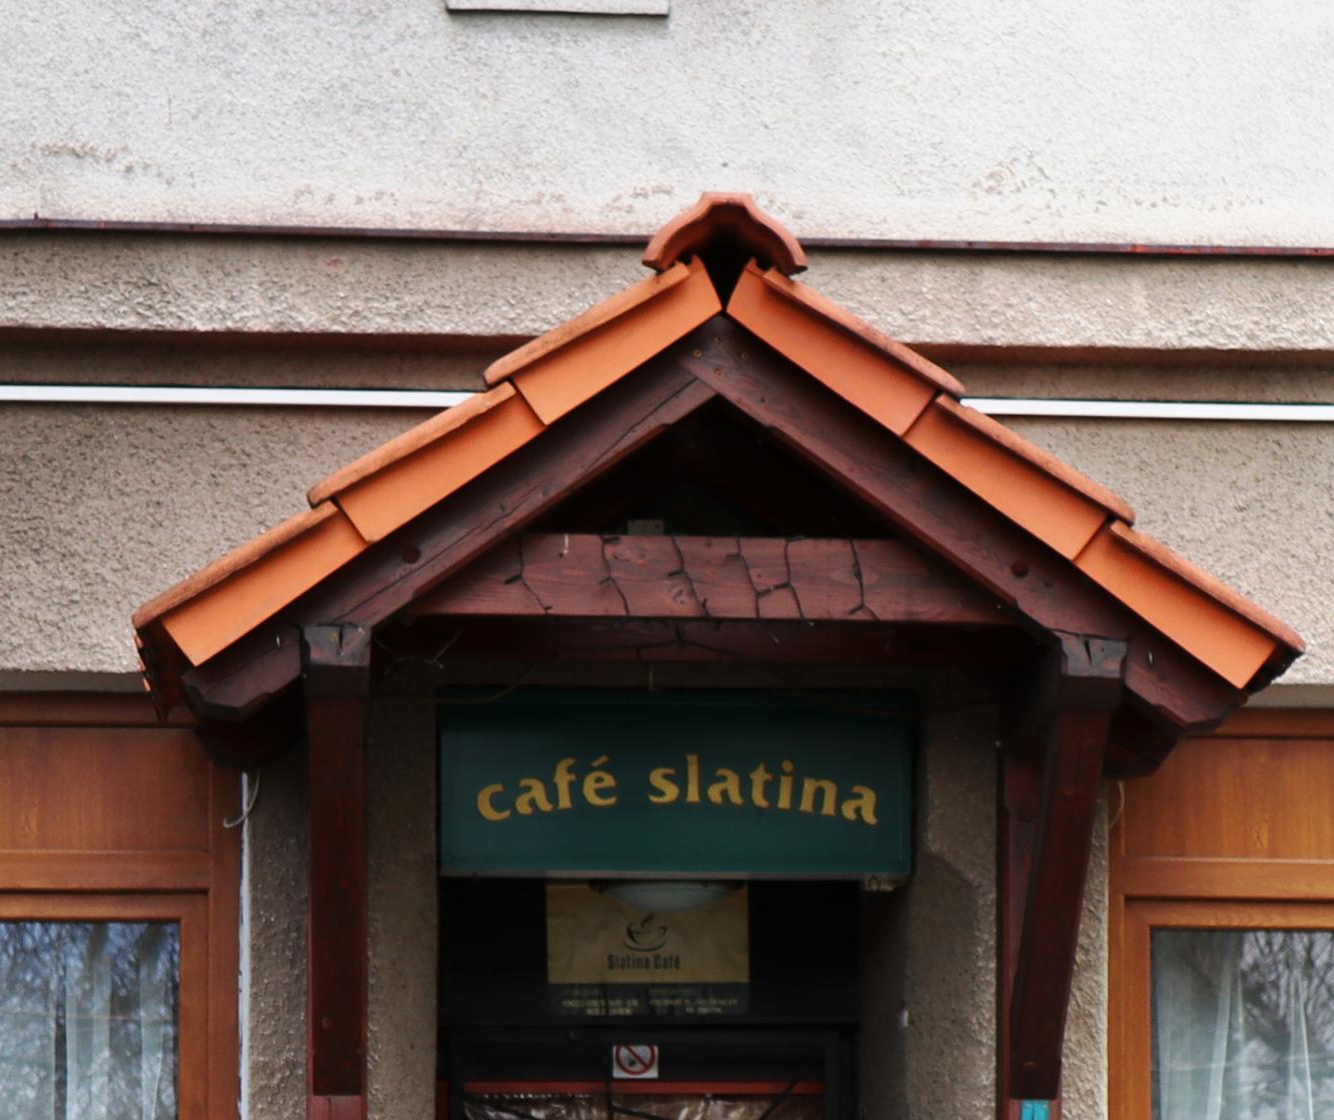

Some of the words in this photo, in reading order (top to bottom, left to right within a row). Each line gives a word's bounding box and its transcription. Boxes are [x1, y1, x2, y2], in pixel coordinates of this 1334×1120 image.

[475, 754, 619, 822] café
[647, 753, 879, 826] slatina
[607, 953, 650, 970] Slatina
